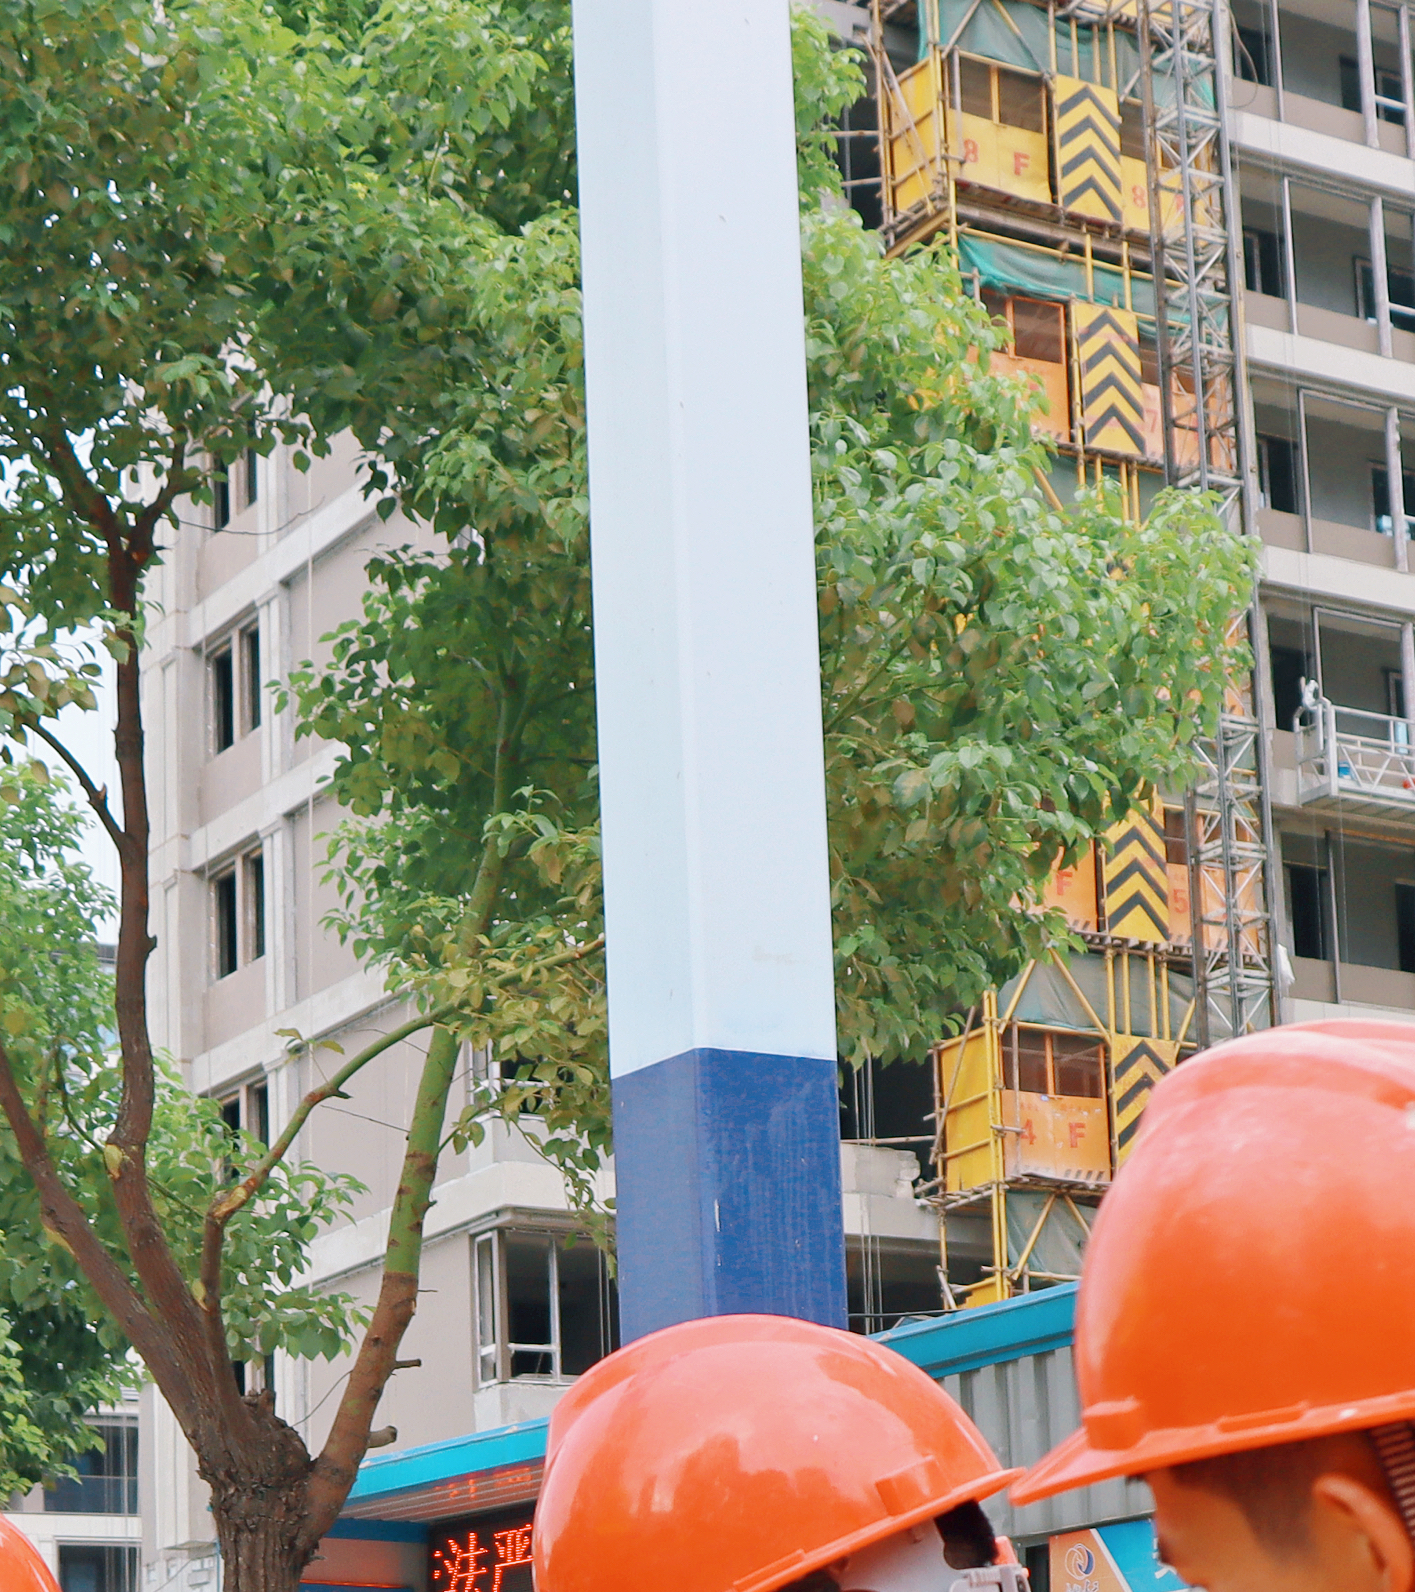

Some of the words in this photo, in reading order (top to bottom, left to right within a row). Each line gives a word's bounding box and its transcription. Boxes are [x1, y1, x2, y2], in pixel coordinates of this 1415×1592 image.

[963, 138, 979, 163] 8
[1013, 151, 1031, 176] F
[1131, 184, 1146, 209] 8
[1055, 869, 1074, 896] F
[1172, 888, 1190, 914] 5
[1020, 1118, 1036, 1146] 4
[1068, 1122, 1086, 1149] F
